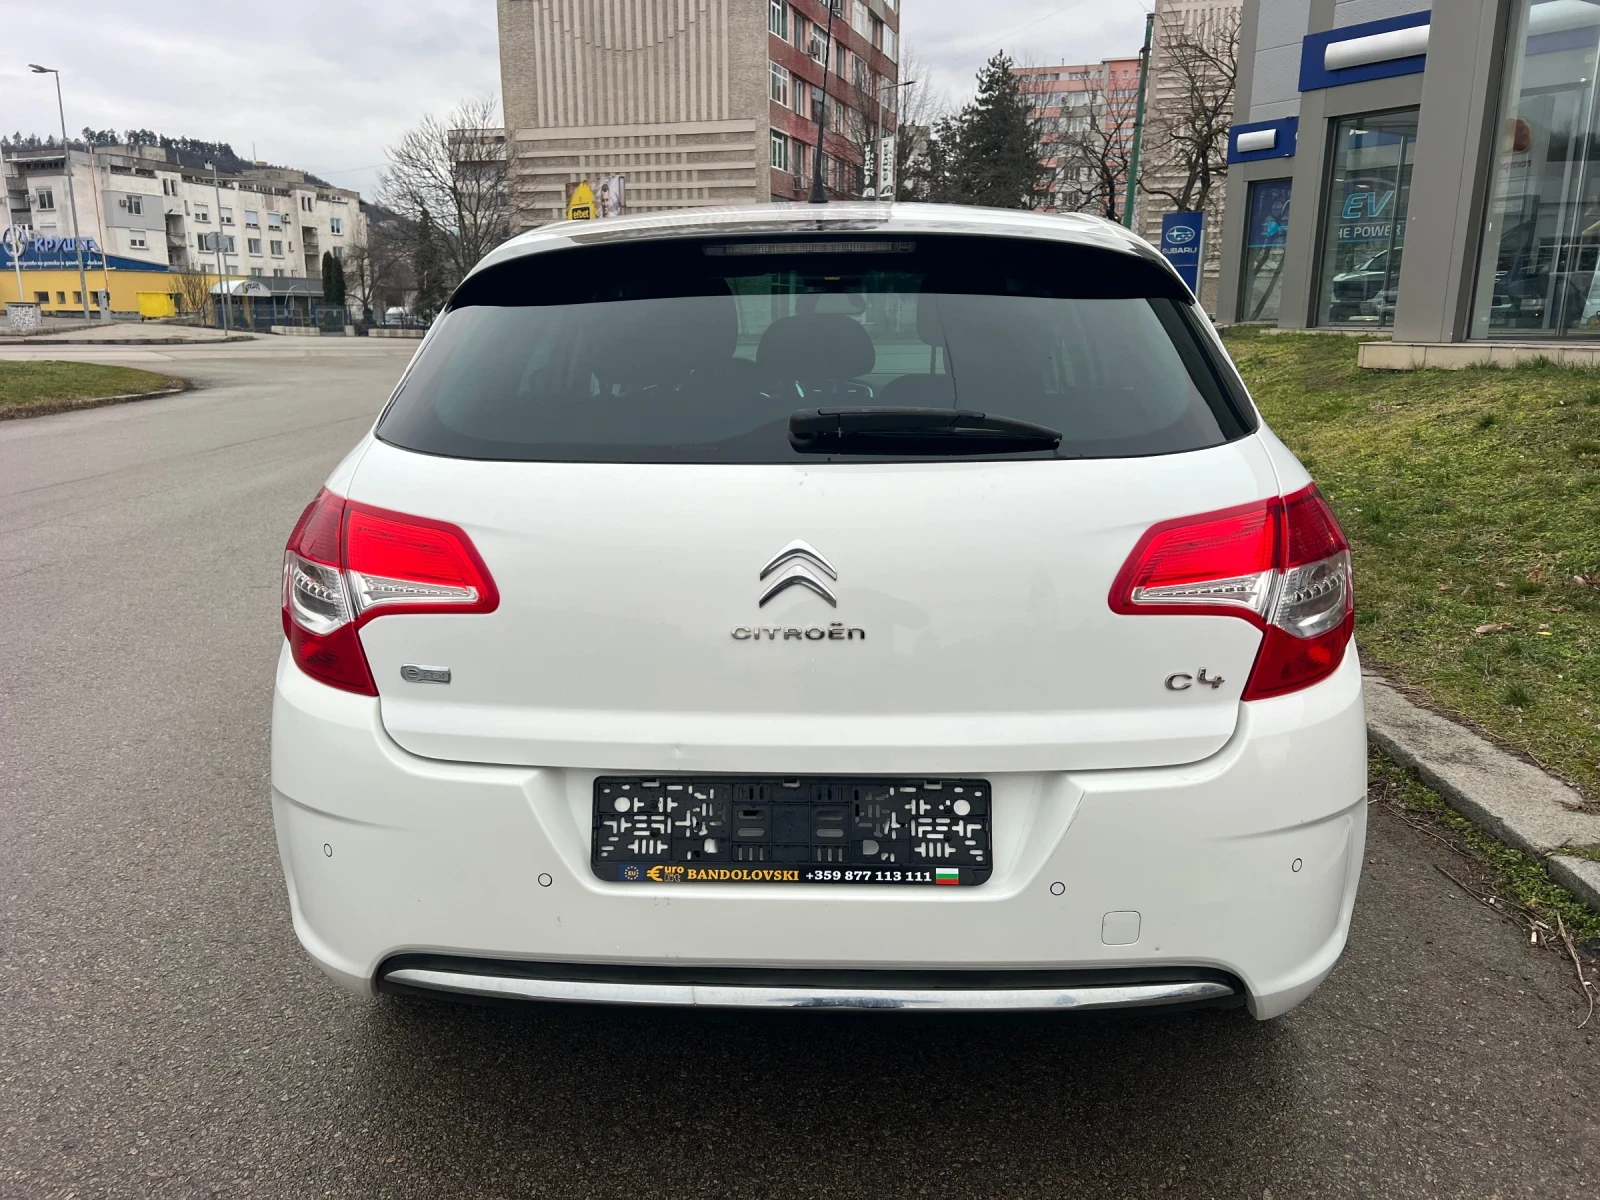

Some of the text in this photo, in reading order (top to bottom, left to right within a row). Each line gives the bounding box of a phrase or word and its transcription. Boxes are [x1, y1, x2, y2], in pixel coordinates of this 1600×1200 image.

[1342, 190, 1394, 219] EV
[1338, 227, 1351, 239] HE
[1165, 667, 1225, 690] C4
[687, 869, 799, 881] BANDOLOVSKI
[806, 870, 841, 880] +359
[844, 870, 872, 881] 877
[875, 871, 902, 881] 113
[905, 871, 932, 882] 111
